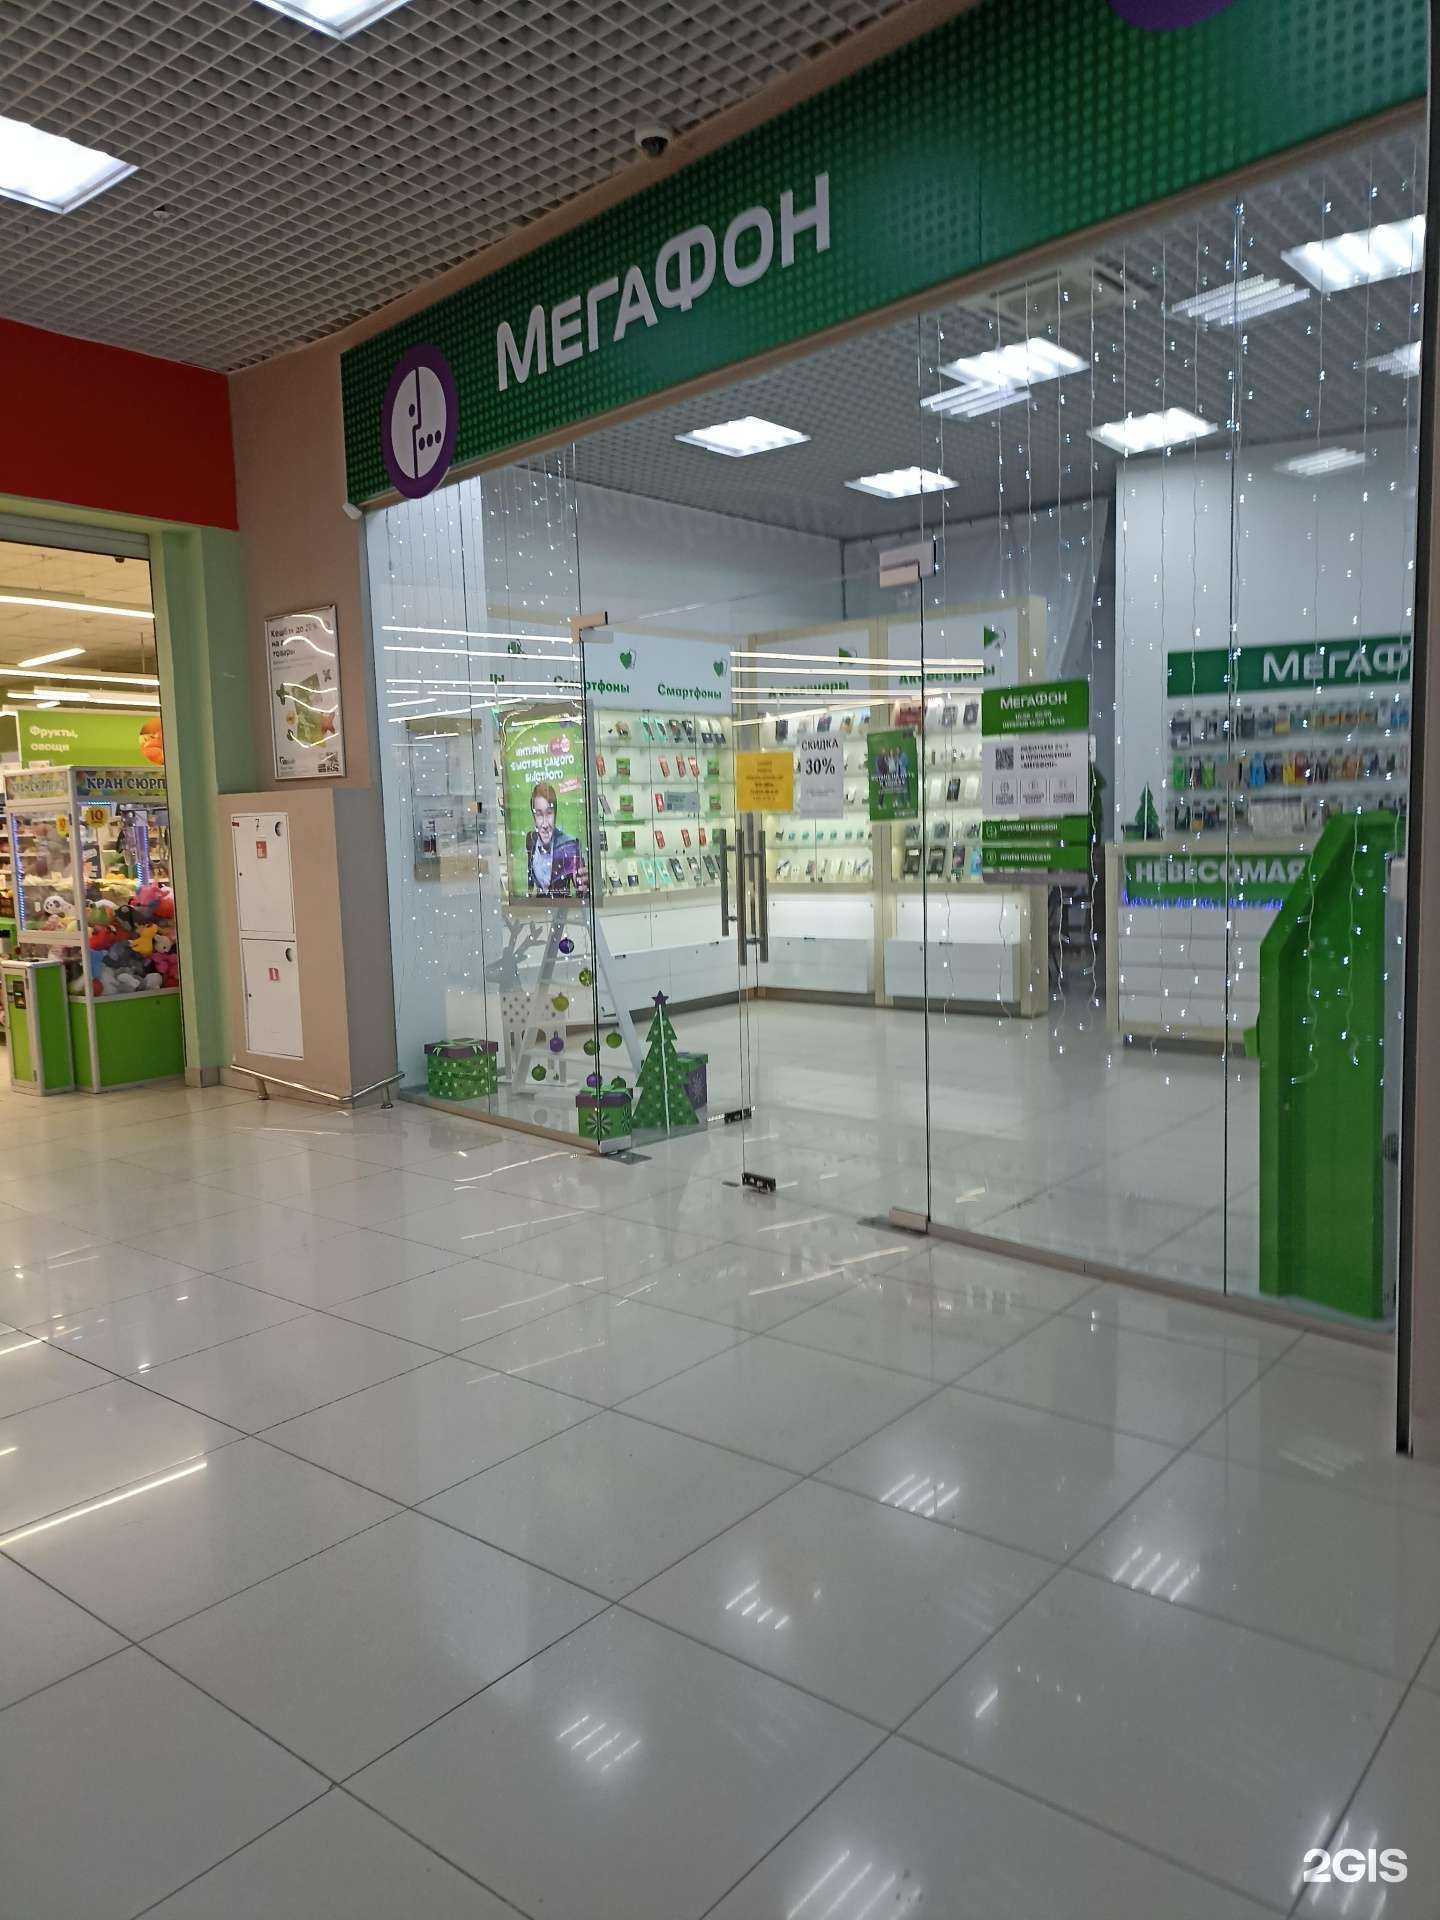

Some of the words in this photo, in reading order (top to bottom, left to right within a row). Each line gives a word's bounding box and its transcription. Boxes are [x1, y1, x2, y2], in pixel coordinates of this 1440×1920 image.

[496, 171, 830, 391] МЕГАФОН
[657, 682, 722, 700] Смартфоны
[801, 738, 839, 752] СКИДКА
[805, 758, 835, 775] 30%
[87, 777, 123, 790] КРАН
[90, 809, 104, 820] 10
